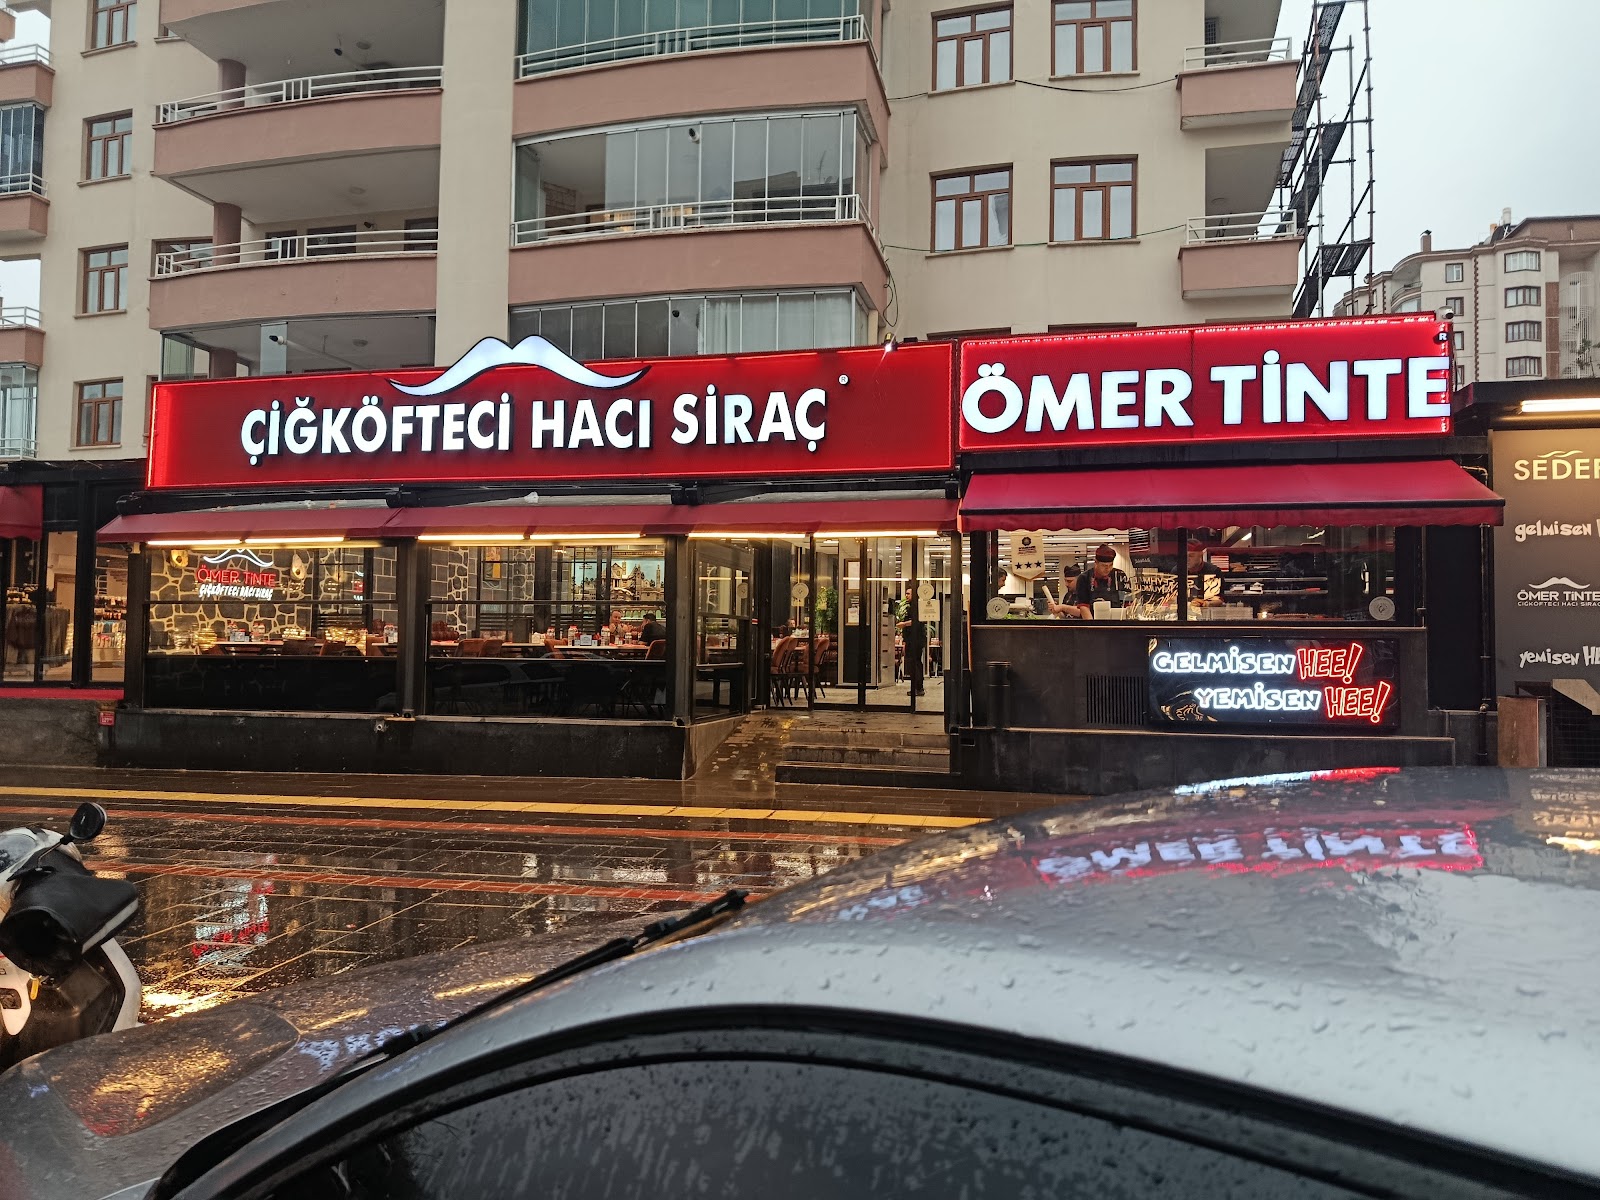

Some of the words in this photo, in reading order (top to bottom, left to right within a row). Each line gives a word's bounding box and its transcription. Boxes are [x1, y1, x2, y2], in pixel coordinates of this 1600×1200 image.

[961, 362, 1194, 434] ÖMER
[1210, 350, 1450, 425] TİNTE
[240, 392, 511, 467] ÇİĞKÖFTECİ
[531, 398, 651, 449] HACI
[670, 384, 826, 452] SİRAÇ
[197, 565, 240, 584] ÖMER
[1516, 589, 1560, 602] ÖMER
[1152, 645, 1296, 674] GELMİSEN
[1296, 642, 1363, 685] HEE!
[1193, 681, 1322, 711] YEMİSEN
[1323, 680, 1391, 724] HEE!
